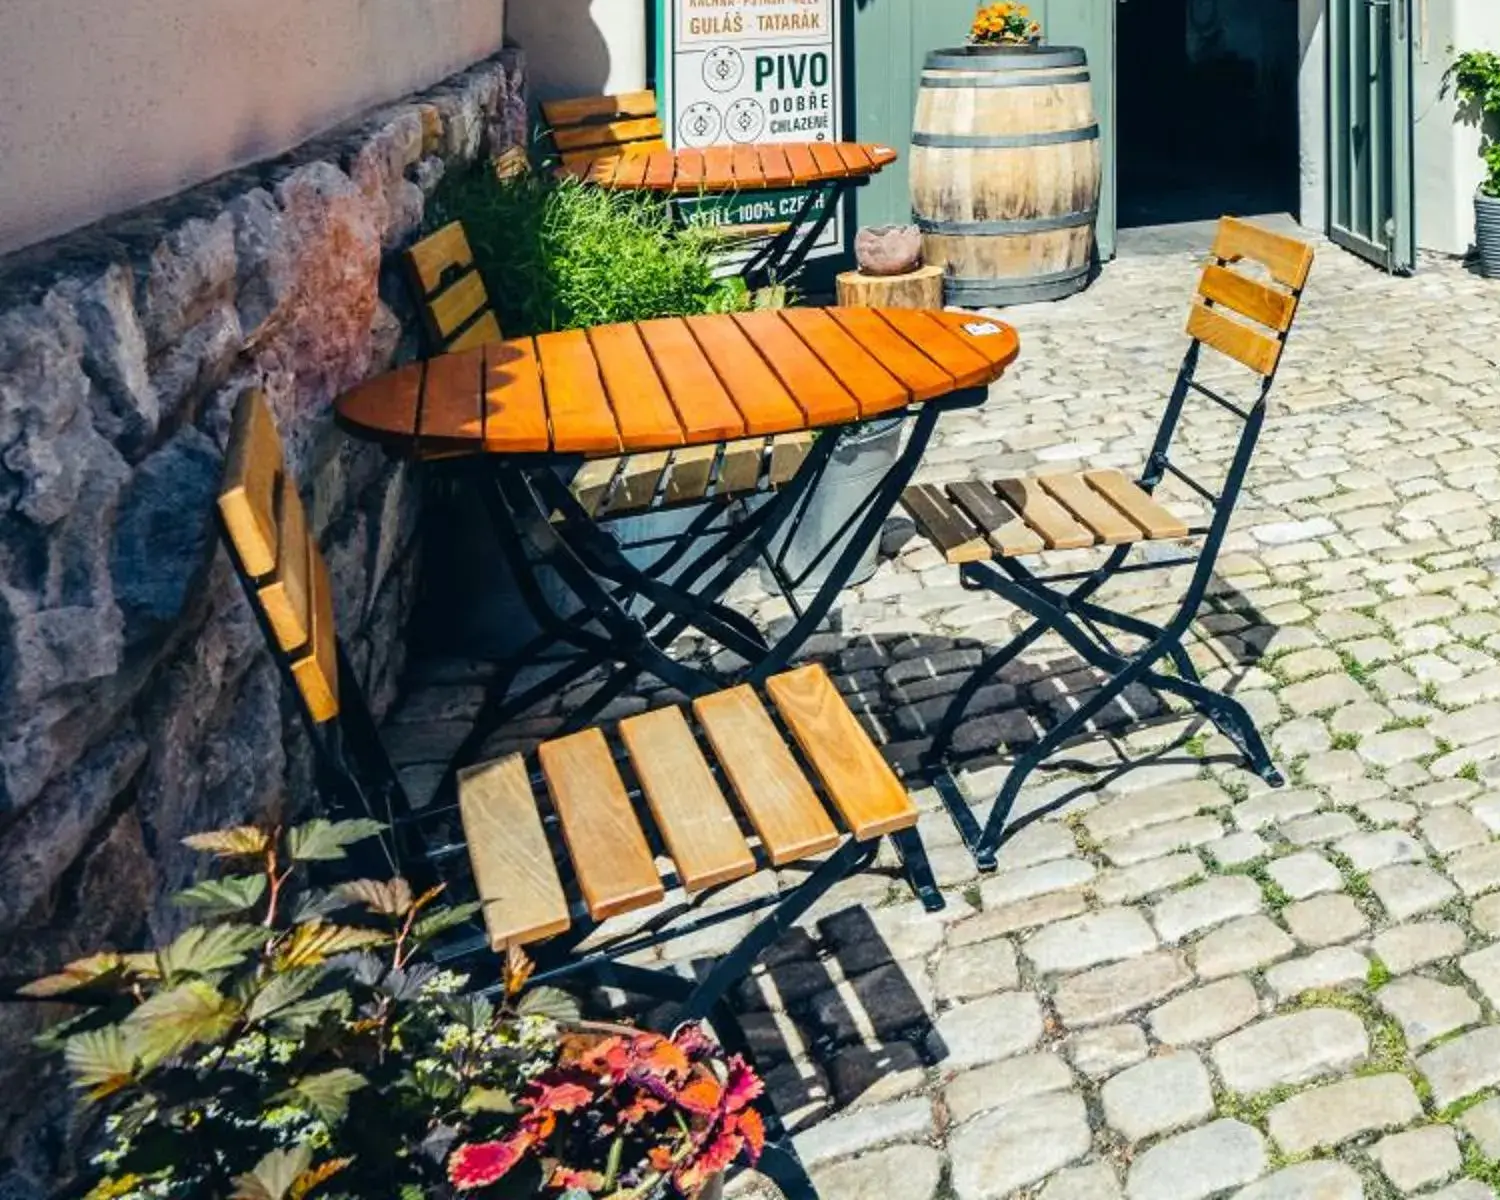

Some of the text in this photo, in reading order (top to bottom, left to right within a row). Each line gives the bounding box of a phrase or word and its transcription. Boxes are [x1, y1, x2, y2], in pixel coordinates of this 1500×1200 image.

[690, 8, 820, 35] GULÁŠ TATARÁK
[755, 51, 828, 92] PIVO
[769, 91, 829, 114] DOBŘE
[739, 200, 777, 223] 100%
[779, 191, 825, 215] CZEH
